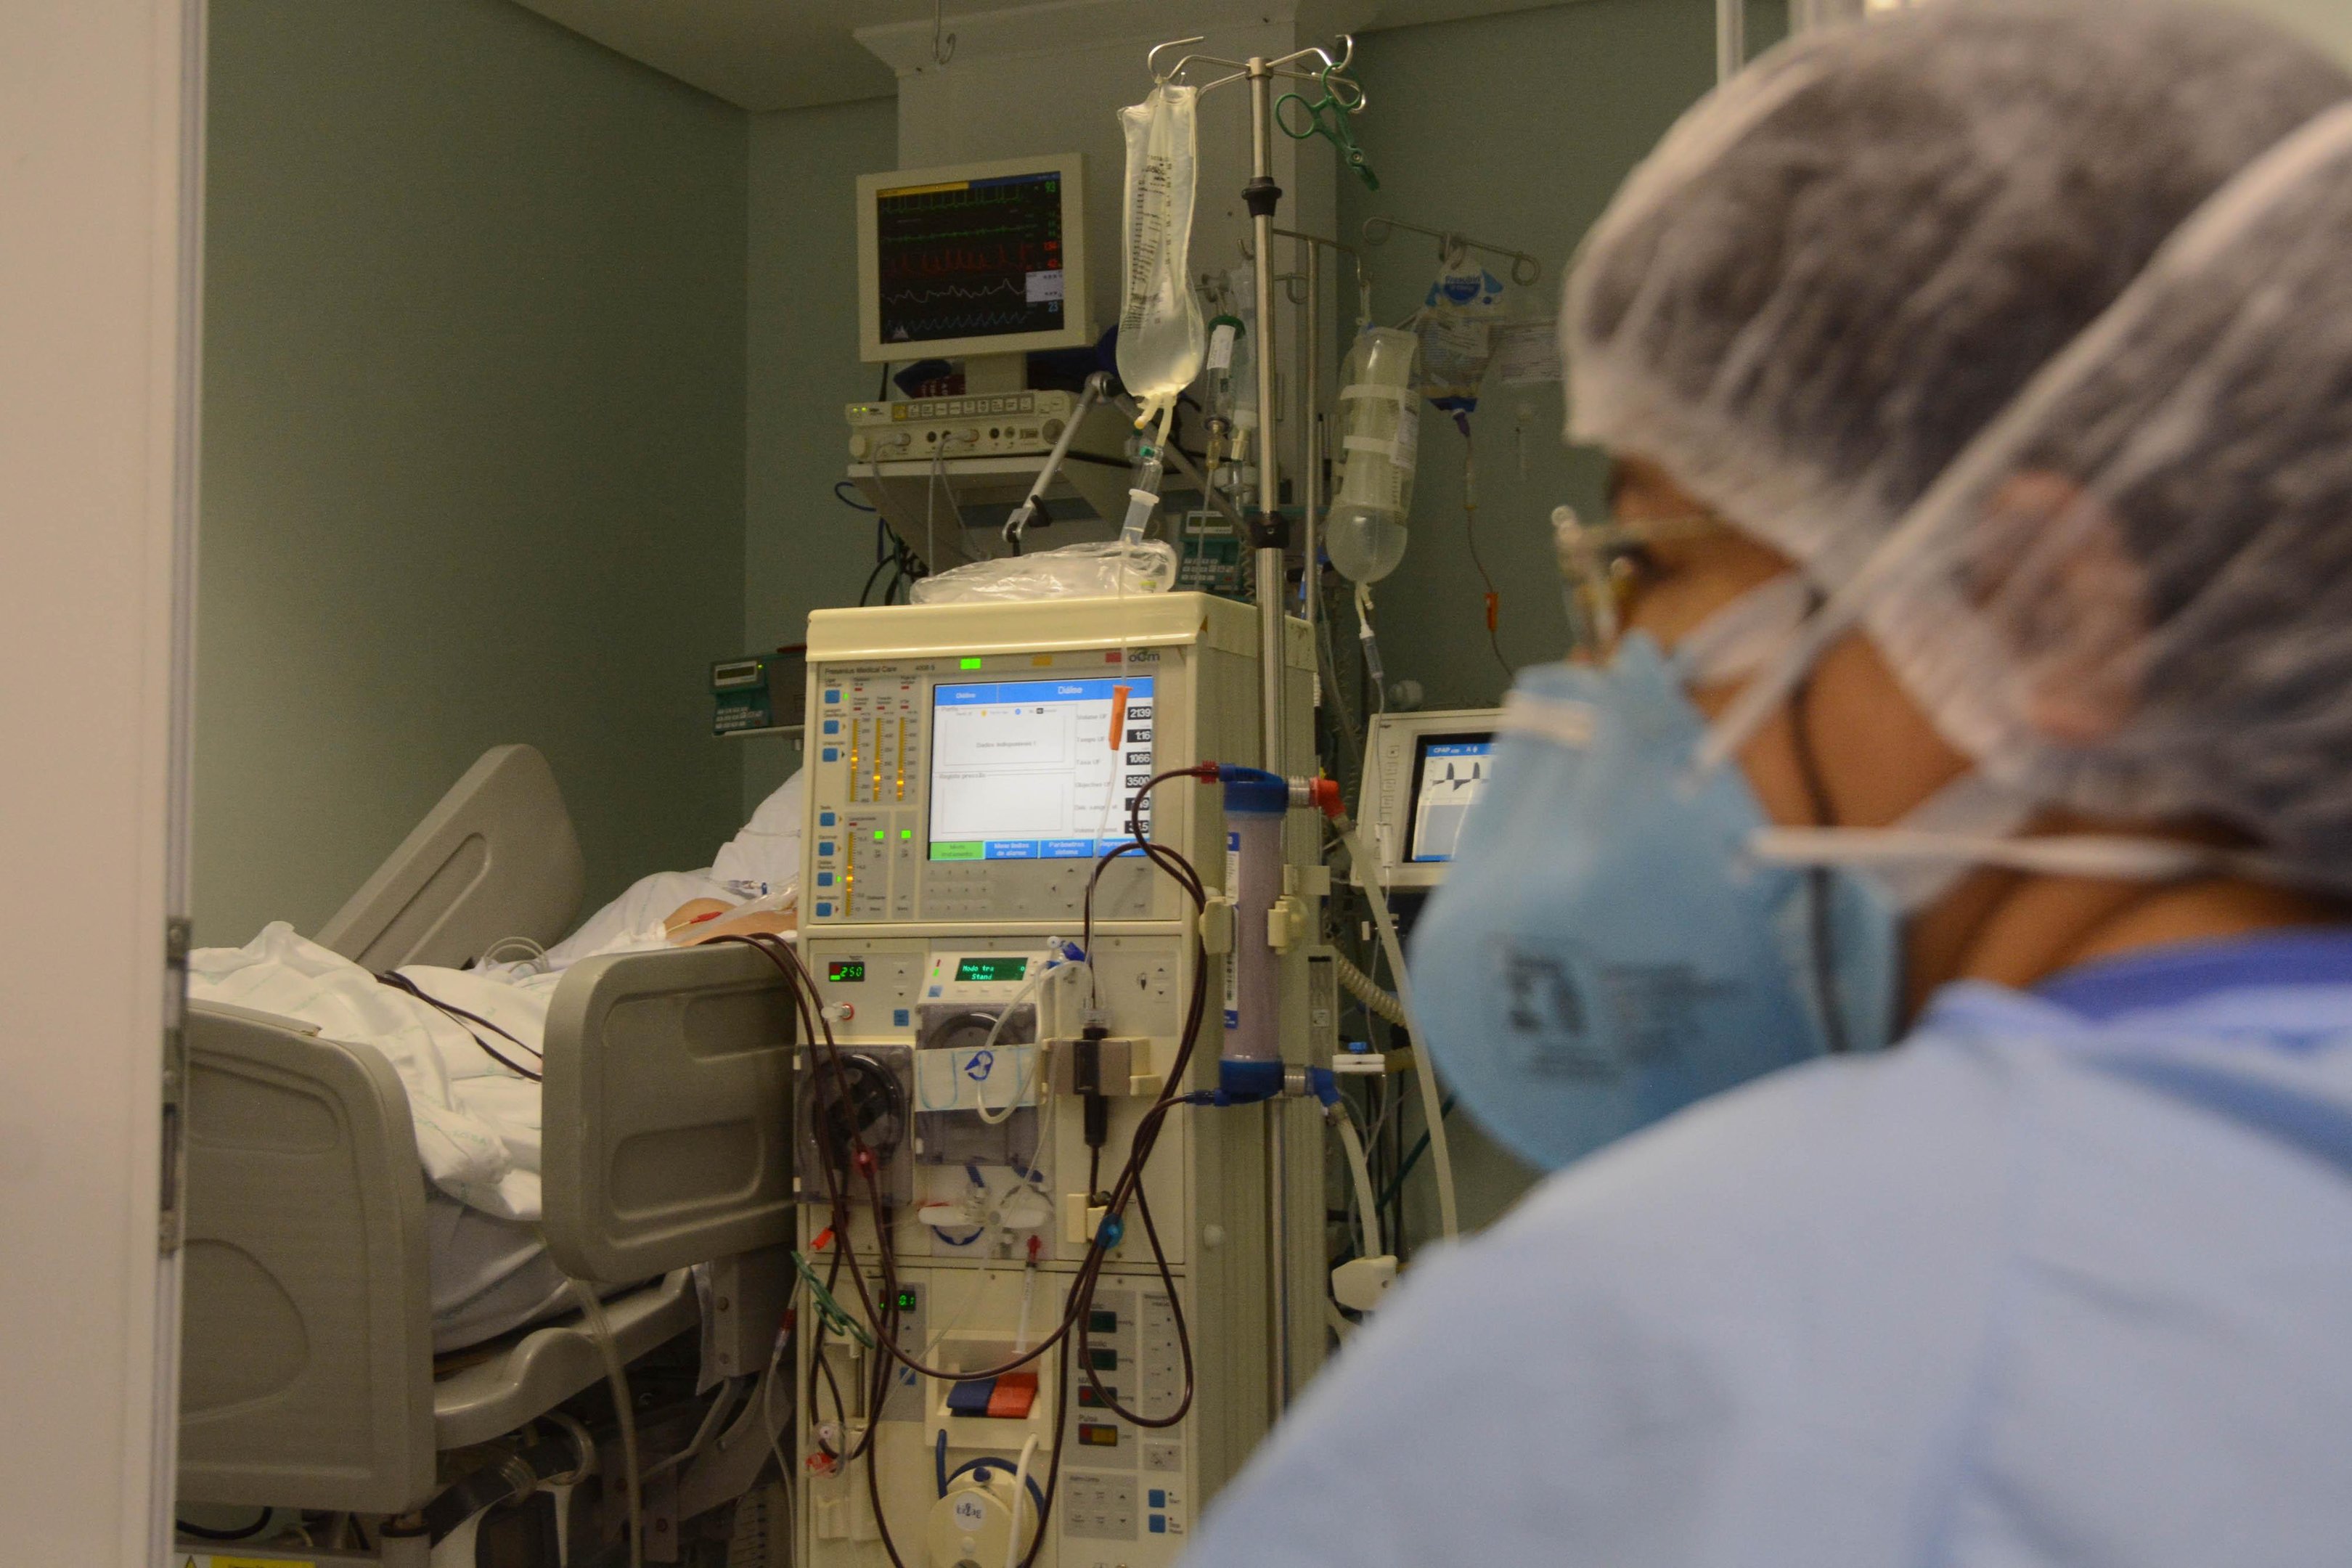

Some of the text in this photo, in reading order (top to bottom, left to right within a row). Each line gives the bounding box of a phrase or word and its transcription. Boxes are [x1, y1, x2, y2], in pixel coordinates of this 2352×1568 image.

[1048, 302, 1058, 312] 23
[1130, 708, 1151, 718] 2139
[1130, 754, 1151, 764] 1066
[1127, 776, 1150, 787] 3500
[840, 966, 862, 977] 250
